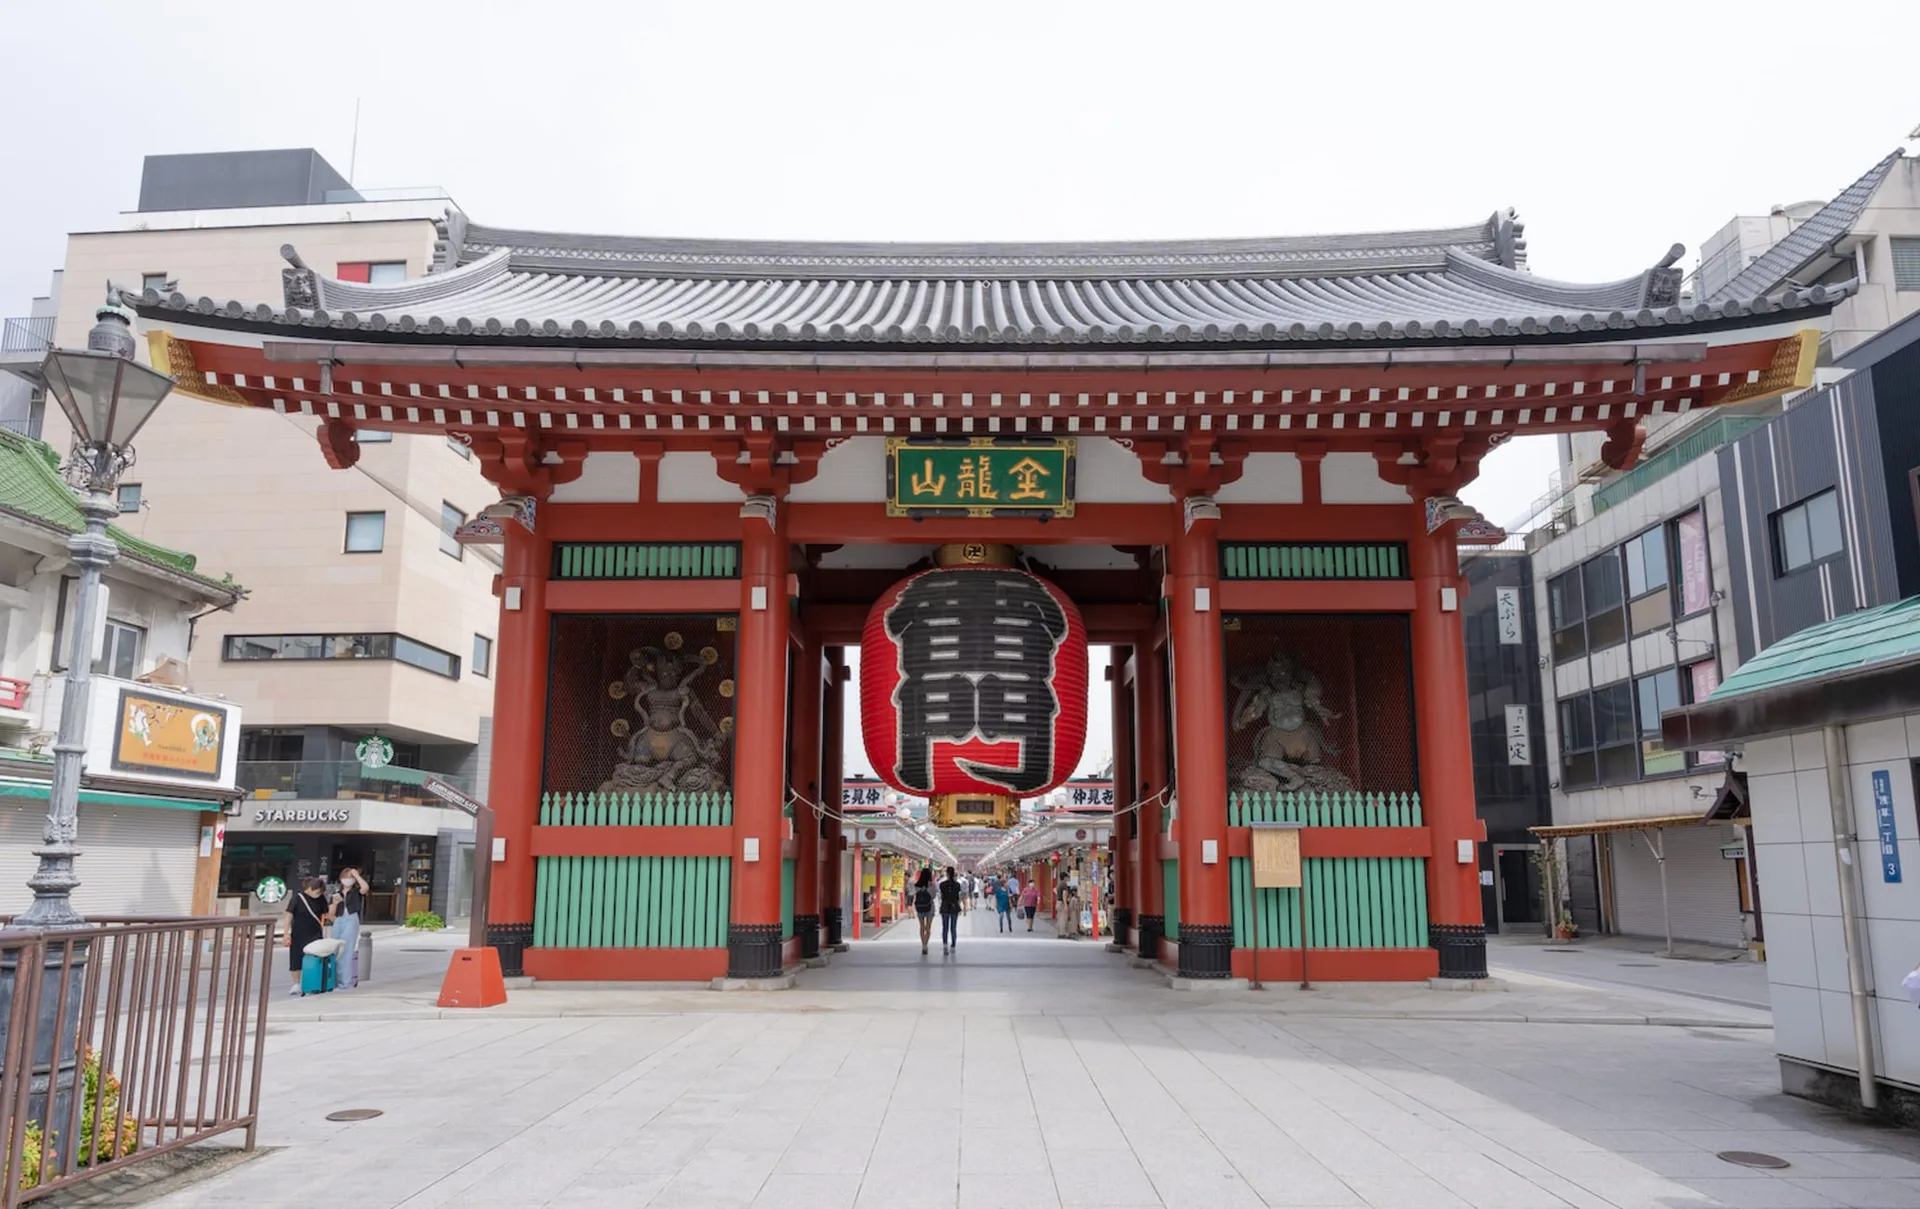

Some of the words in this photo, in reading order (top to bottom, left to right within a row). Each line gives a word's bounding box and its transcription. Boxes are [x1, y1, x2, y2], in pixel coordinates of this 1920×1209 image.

[884, 567, 1069, 792] 雷門
[254, 809, 349, 822] STARBUCKS
[1887, 863, 1896, 876] 3
